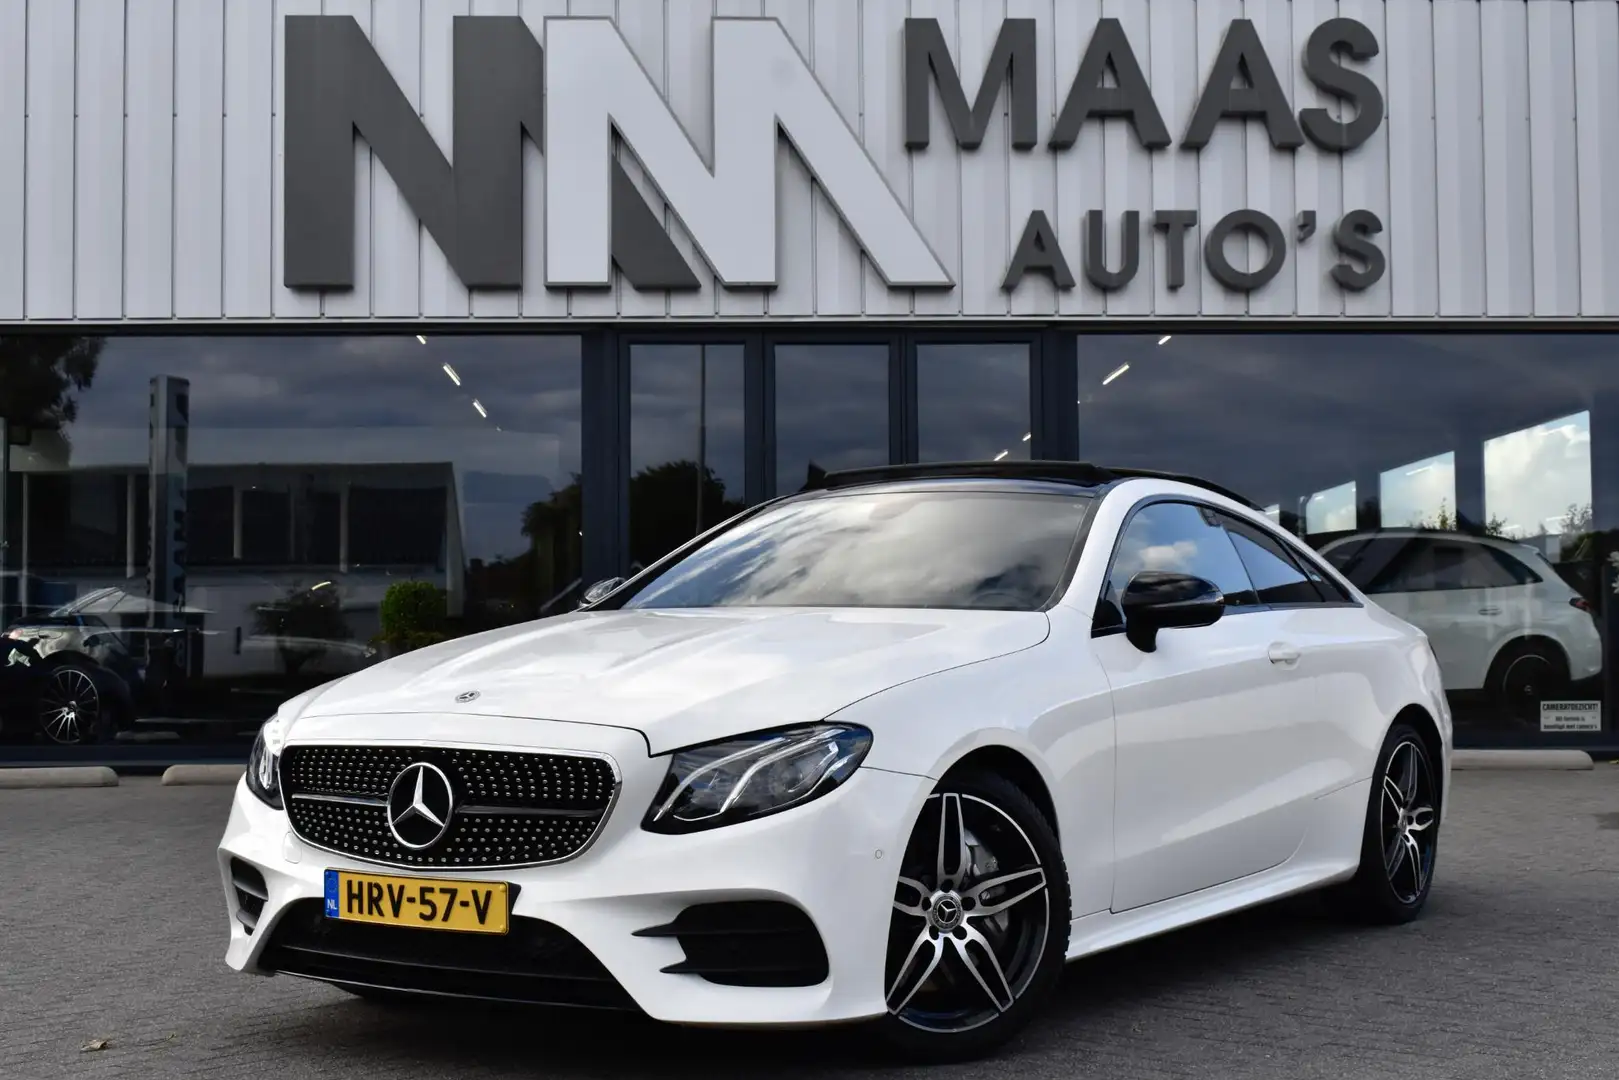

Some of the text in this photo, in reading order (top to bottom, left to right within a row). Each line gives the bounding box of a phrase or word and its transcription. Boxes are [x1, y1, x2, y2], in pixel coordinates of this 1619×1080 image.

[905, 17, 1384, 152] MAAS
[1001, 209, 1386, 291] AUTO'S
[327, 898, 338, 910] NL
[346, 879, 493, 926] HRV-57-V
